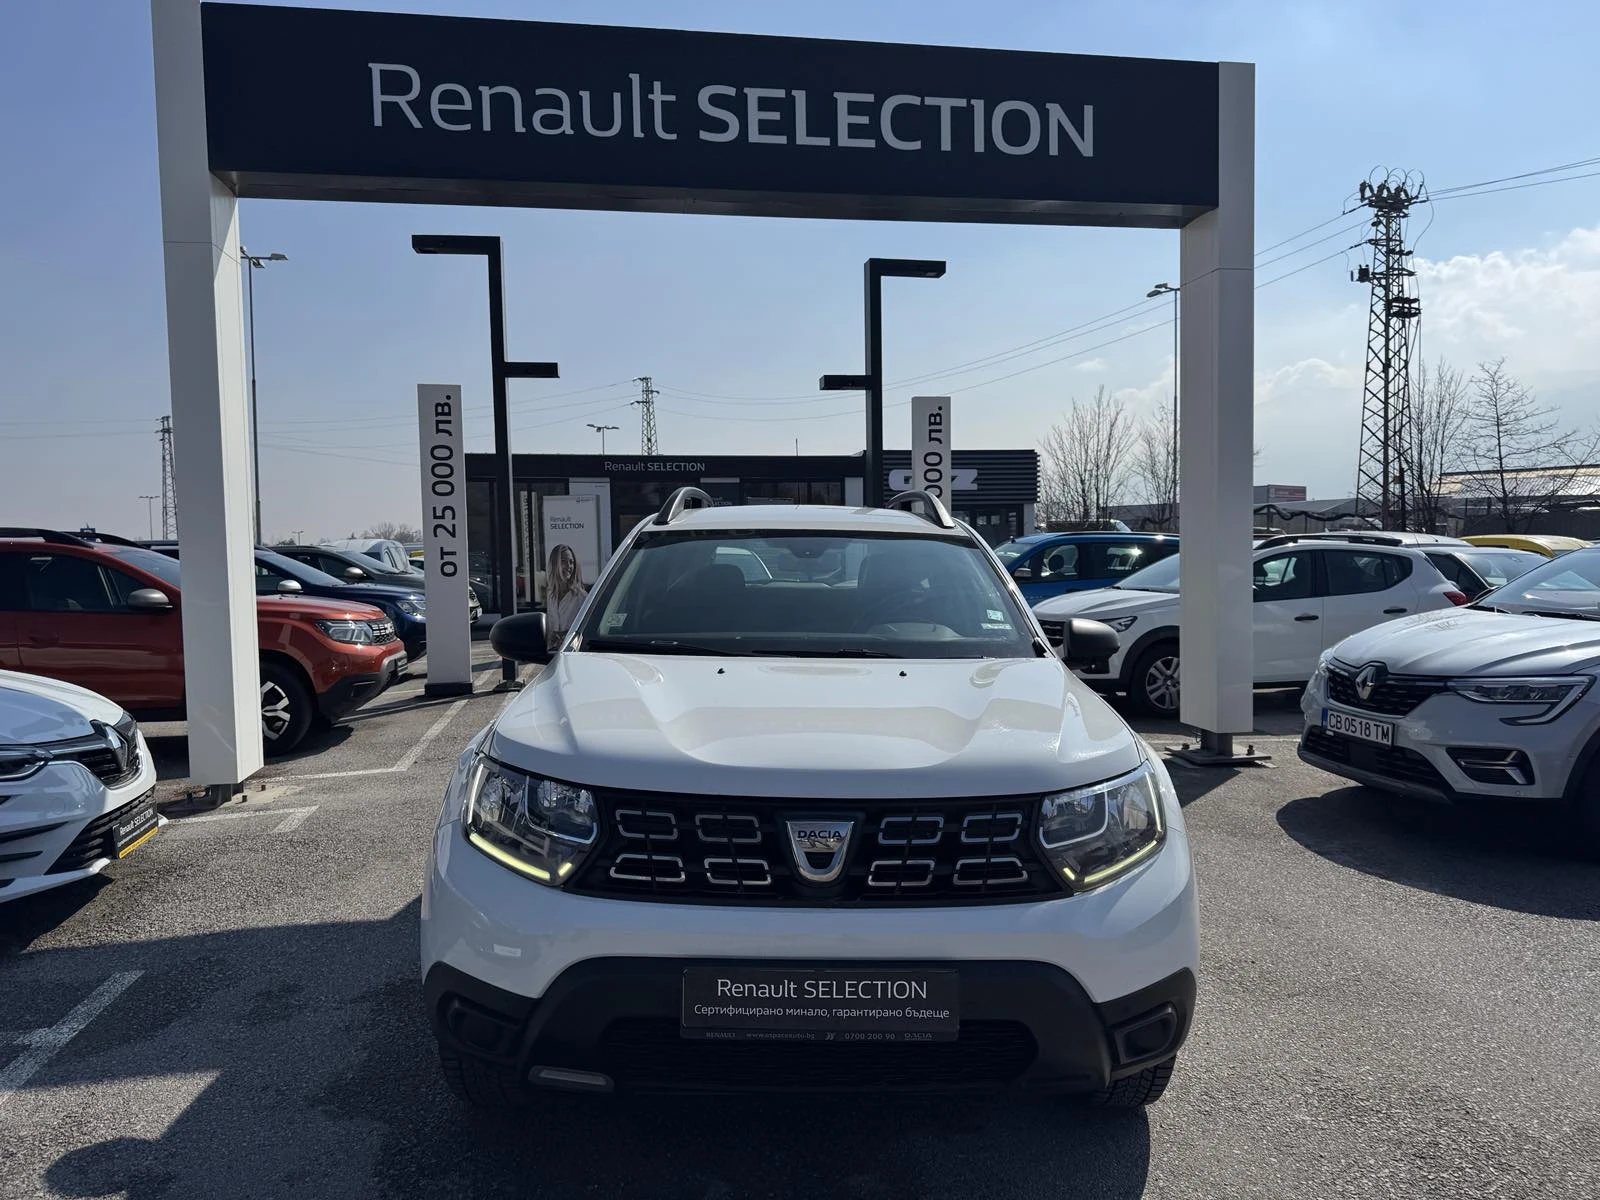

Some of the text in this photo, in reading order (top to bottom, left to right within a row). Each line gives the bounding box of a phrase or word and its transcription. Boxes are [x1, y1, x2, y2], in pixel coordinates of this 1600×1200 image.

[368, 62, 1096, 158] Renault SELECTION
[430, 444, 455, 498] 000
[603, 460, 706, 472] Renault SELECTION
[433, 505, 456, 539] 25
[550, 522, 585, 531] SELECTION
[1344, 716, 1372, 738] 0518
[1373, 723, 1391, 743] TM
[134, 808, 154, 827] SELECTION
[797, 830, 842, 839] DACIA
[716, 979, 928, 999] Renault SELECTION
[694, 1004, 950, 1019] Сертифицирано минало, гарантирано бъдеще
[844, 1033, 866, 1041] 0700
[867, 1033, 884, 1041] 200
[885, 1033, 896, 1041] 90
